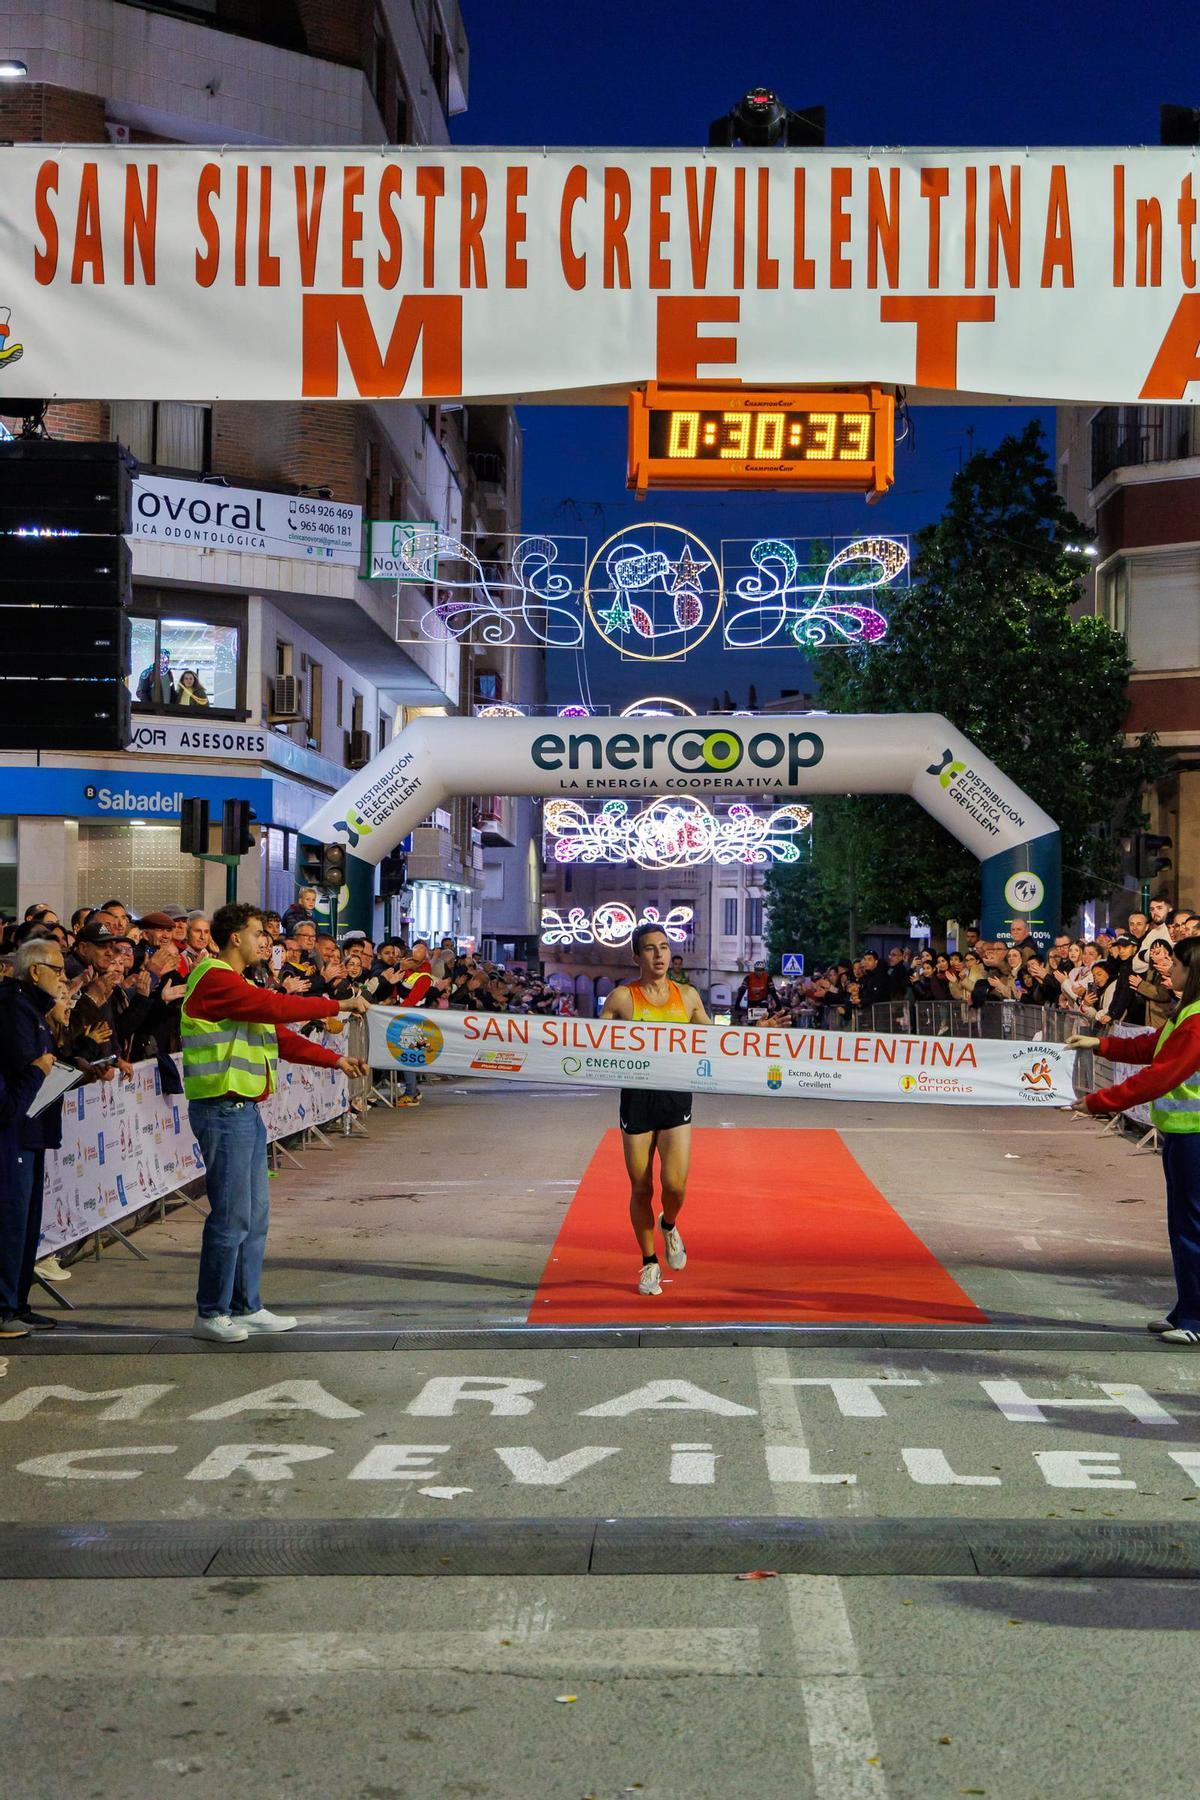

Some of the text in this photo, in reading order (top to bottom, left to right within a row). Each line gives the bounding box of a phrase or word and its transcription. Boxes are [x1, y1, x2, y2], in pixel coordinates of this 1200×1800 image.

[35, 160, 157, 285] SAN
[195, 163, 528, 290] SILVESTRE
[560, 165, 1075, 290] CREVILLENTINA
[668, 411, 871, 460] 0:30:33
[299, 504, 354, 519] 654 926 469
[165, 527, 266, 548] ODONTOLÓGICA
[300, 521, 352, 536] 965 406 181
[180, 732, 265, 752] ASESORES
[531, 729, 825, 786] enercoop
[355, 752, 414, 810] DISTRIBUCIÓN
[560, 777, 783, 789] LA ENERGÍA COOPERATIVA
[97, 788, 184, 813] Sabadell
[372, 777, 422, 826] CREVILLENT
[956, 778, 1001, 823] ELÉCTRICA
[965, 769, 1025, 827] DISTRIBUCIÓN
[949, 788, 1000, 836] CREVILLENT
[463, 1015, 977, 1068] SAN SILVESTRE CREVILLENTINA
[400, 1053, 426, 1064] SSC
[1027, 1046, 1061, 1061] MARATHON
[586, 1058, 650, 1070] ENERCOOP
[788, 1069, 812, 1078] Excmo.
[814, 1071, 831, 1080] Ayto.
[798, 1080, 832, 1089] Crevillent
[918, 1071, 959, 1085] Gruas
[1018, 1091, 1056, 1102] CREVILLENT
